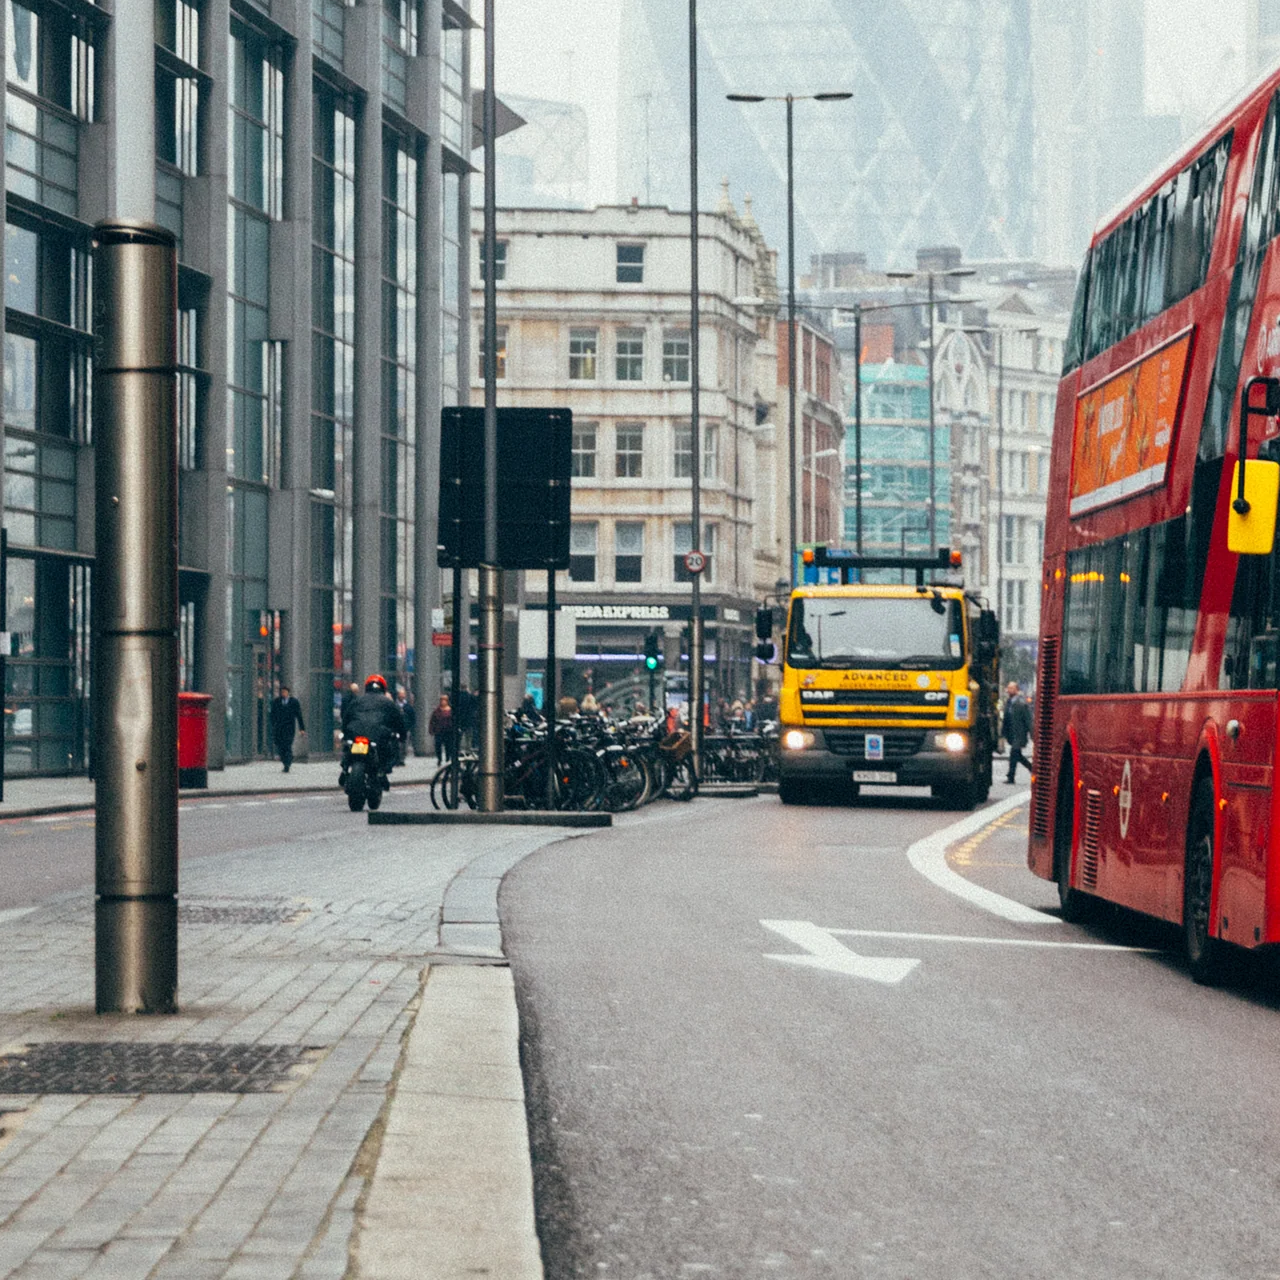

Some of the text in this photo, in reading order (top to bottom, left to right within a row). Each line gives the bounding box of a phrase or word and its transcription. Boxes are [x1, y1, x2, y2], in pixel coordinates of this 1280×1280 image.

[688, 556, 703, 566] 20
[842, 672, 909, 682] ADVANCED
[802, 690, 835, 699] DAF
[924, 692, 949, 701] CF
